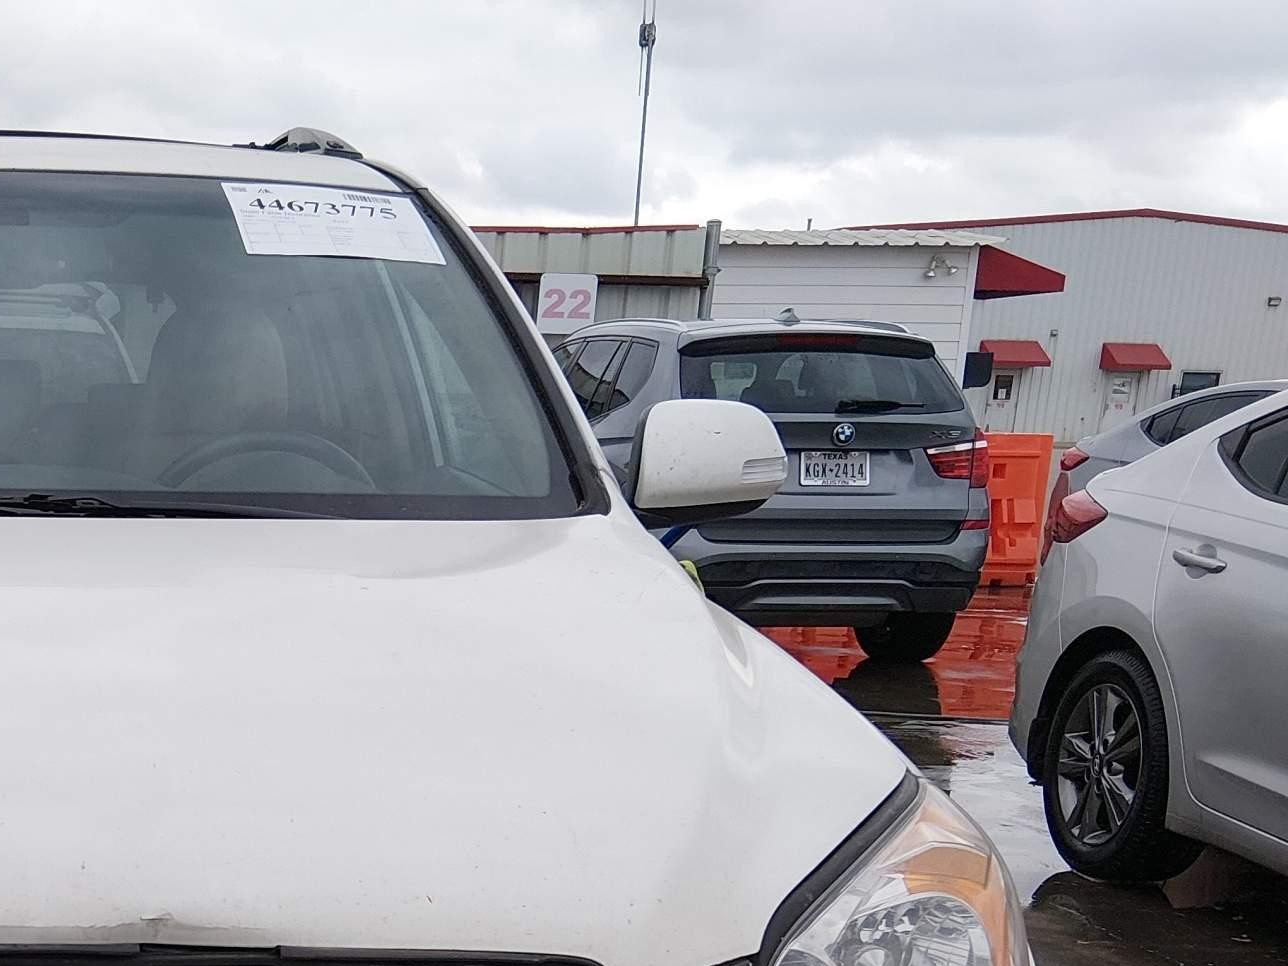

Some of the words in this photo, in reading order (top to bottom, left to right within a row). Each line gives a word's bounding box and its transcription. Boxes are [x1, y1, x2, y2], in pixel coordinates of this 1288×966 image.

[248, 198, 398, 220] 44673775
[541, 288, 592, 320] 22
[929, 430, 962, 440] X3
